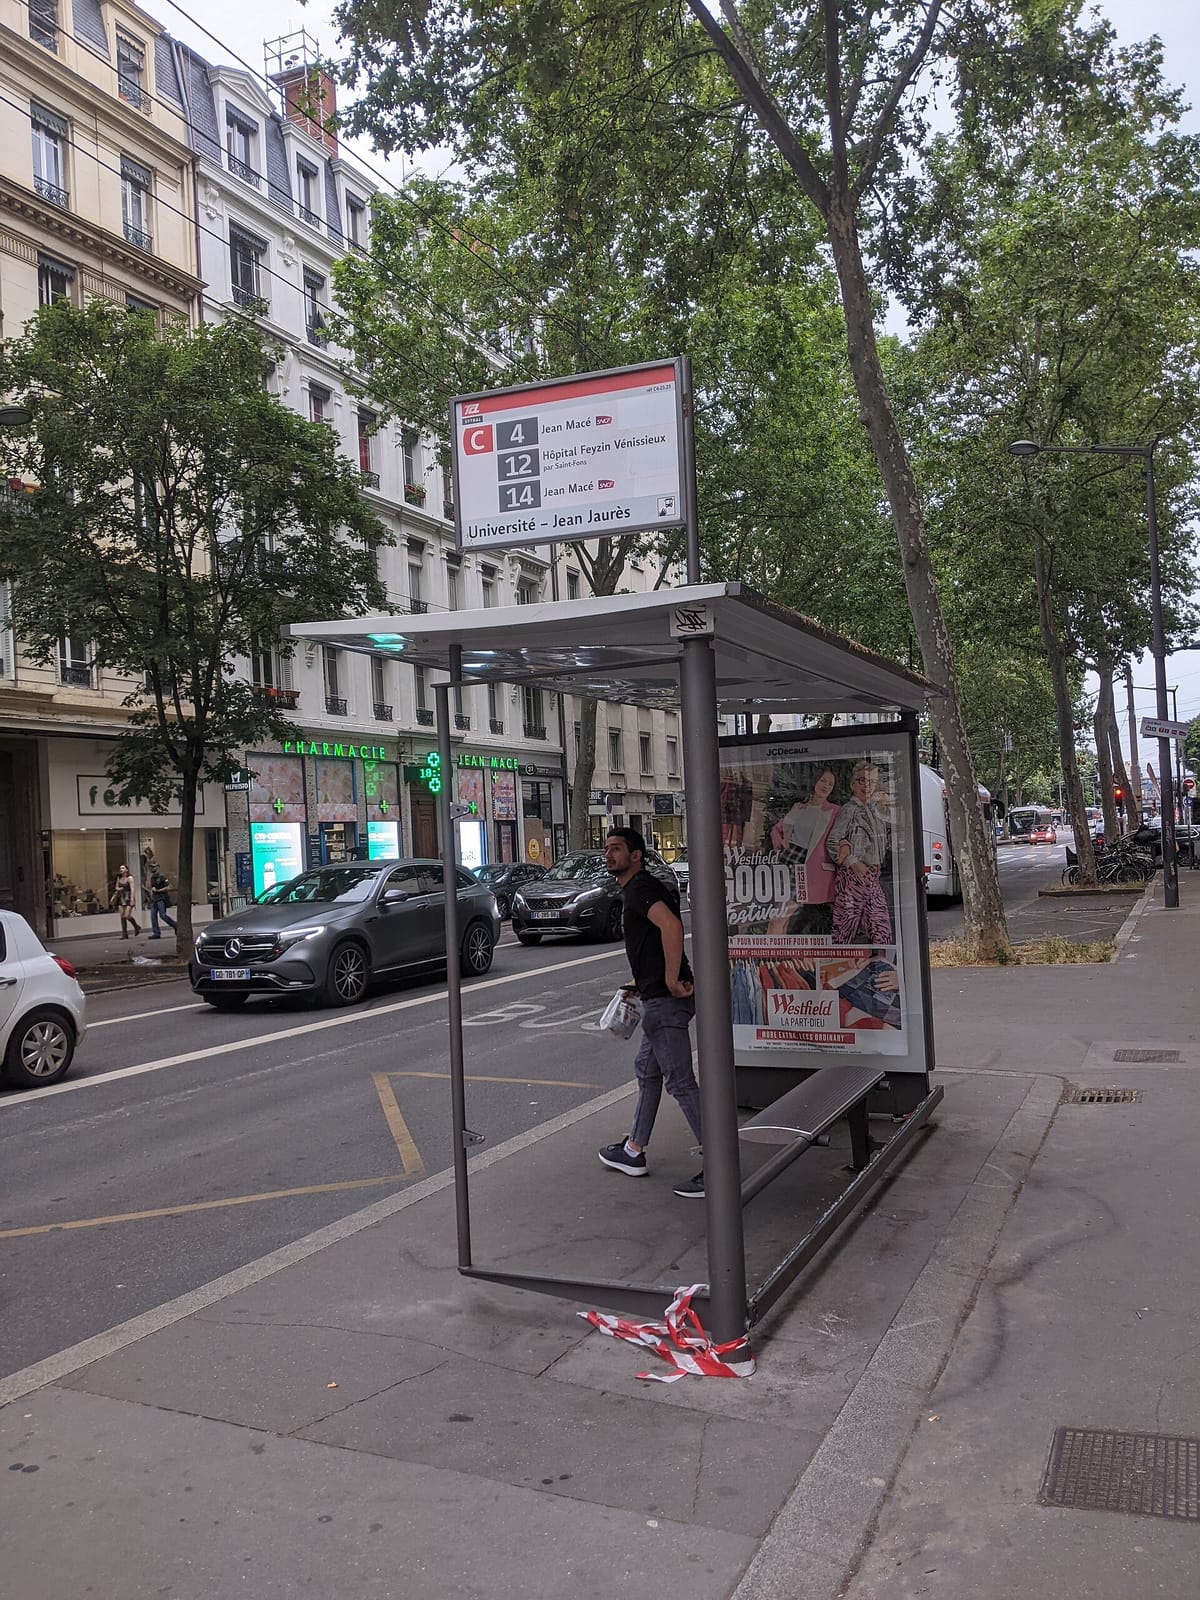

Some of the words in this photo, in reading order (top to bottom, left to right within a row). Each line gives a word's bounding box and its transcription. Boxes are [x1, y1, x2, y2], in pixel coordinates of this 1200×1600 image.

[510, 423, 525, 443] 4
[541, 423, 562, 434] Jean
[566, 417, 592, 430] Macé
[471, 430, 485, 450] C
[543, 446, 577, 461] Hôpital
[580, 442, 611, 455] Feyzin
[614, 434, 666, 449] Vénissieux
[504, 453, 532, 477] 12
[555, 459, 587, 469] Saint-Fons
[506, 485, 534, 508] 14
[544, 487, 565, 497] Jean
[568, 481, 594, 493] Macé
[468, 517, 536, 539] Université
[553, 514, 583, 528] Jean
[587, 507, 631, 523] Jaurès
[284, 741, 385, 760] PHARMACIE
[766, 747, 809, 757] JCDecaux
[458, 754, 485, 766] JEAN
[490, 758, 518, 769] MACE
[726, 846, 781, 865] Westfield
[798, 872, 805, 881] 13
[737, 937, 751, 946] POUR
[770, 937, 792, 946] POSITIF
[793, 937, 809, 946] POUR
[810, 937, 825, 946] TOUS
[771, 993, 834, 1016] Westfield
[781, 1018, 790, 1027] LA
[791, 1018, 825, 1028] PART-DIEU
[762, 1031, 778, 1039] MORE
[800, 1033, 813, 1041] LESS
[814, 1033, 845, 1042] ORDINARY
